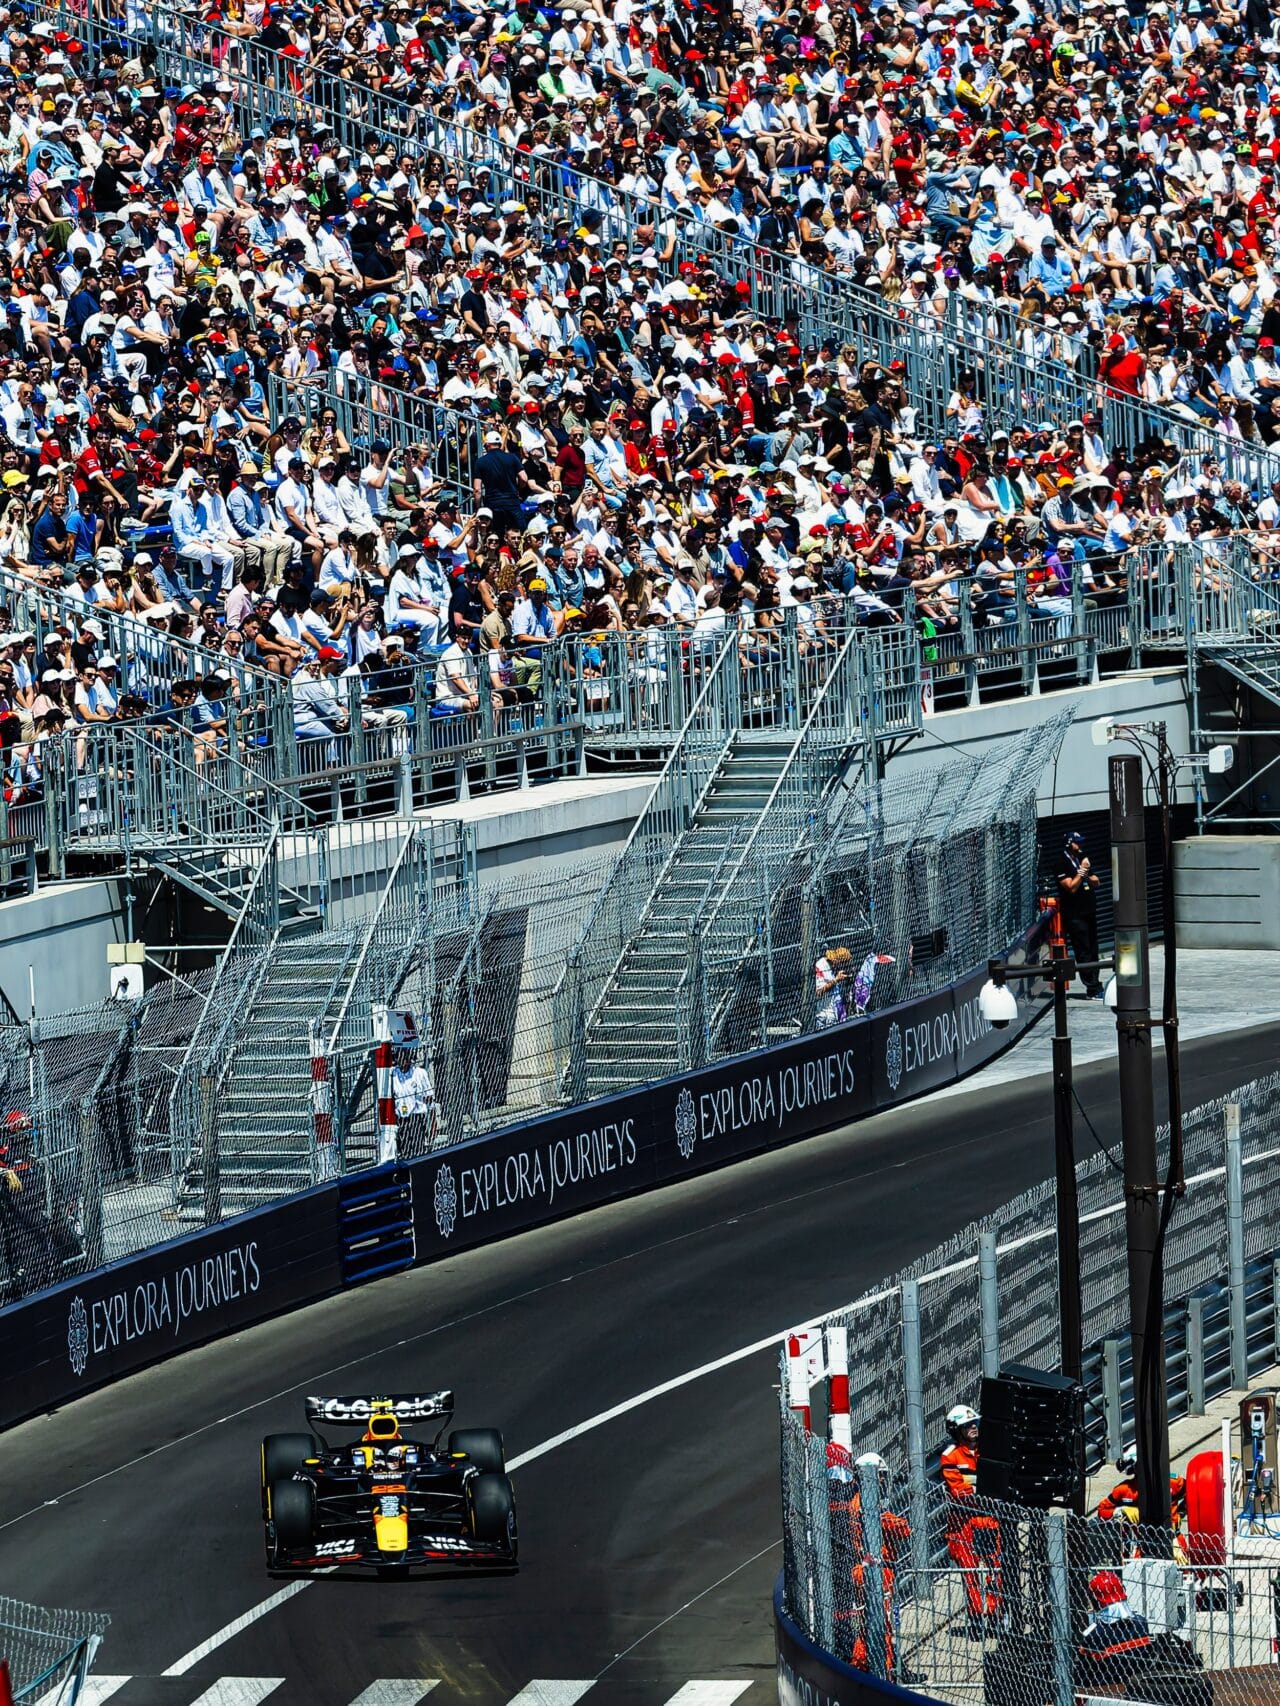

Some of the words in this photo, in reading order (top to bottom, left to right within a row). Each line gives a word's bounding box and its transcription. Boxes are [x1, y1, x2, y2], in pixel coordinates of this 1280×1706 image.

[905, 1010, 960, 1072] EXPLORA
[700, 1075, 776, 1140] EXPLORA
[778, 1049, 855, 1129] JOURNEYS
[460, 1149, 546, 1218] EXPLORA
[548, 1118, 637, 1205] JOURNEYS
[91, 1276, 172, 1354] EXPLORA
[174, 1241, 261, 1336] JOURNEYS
